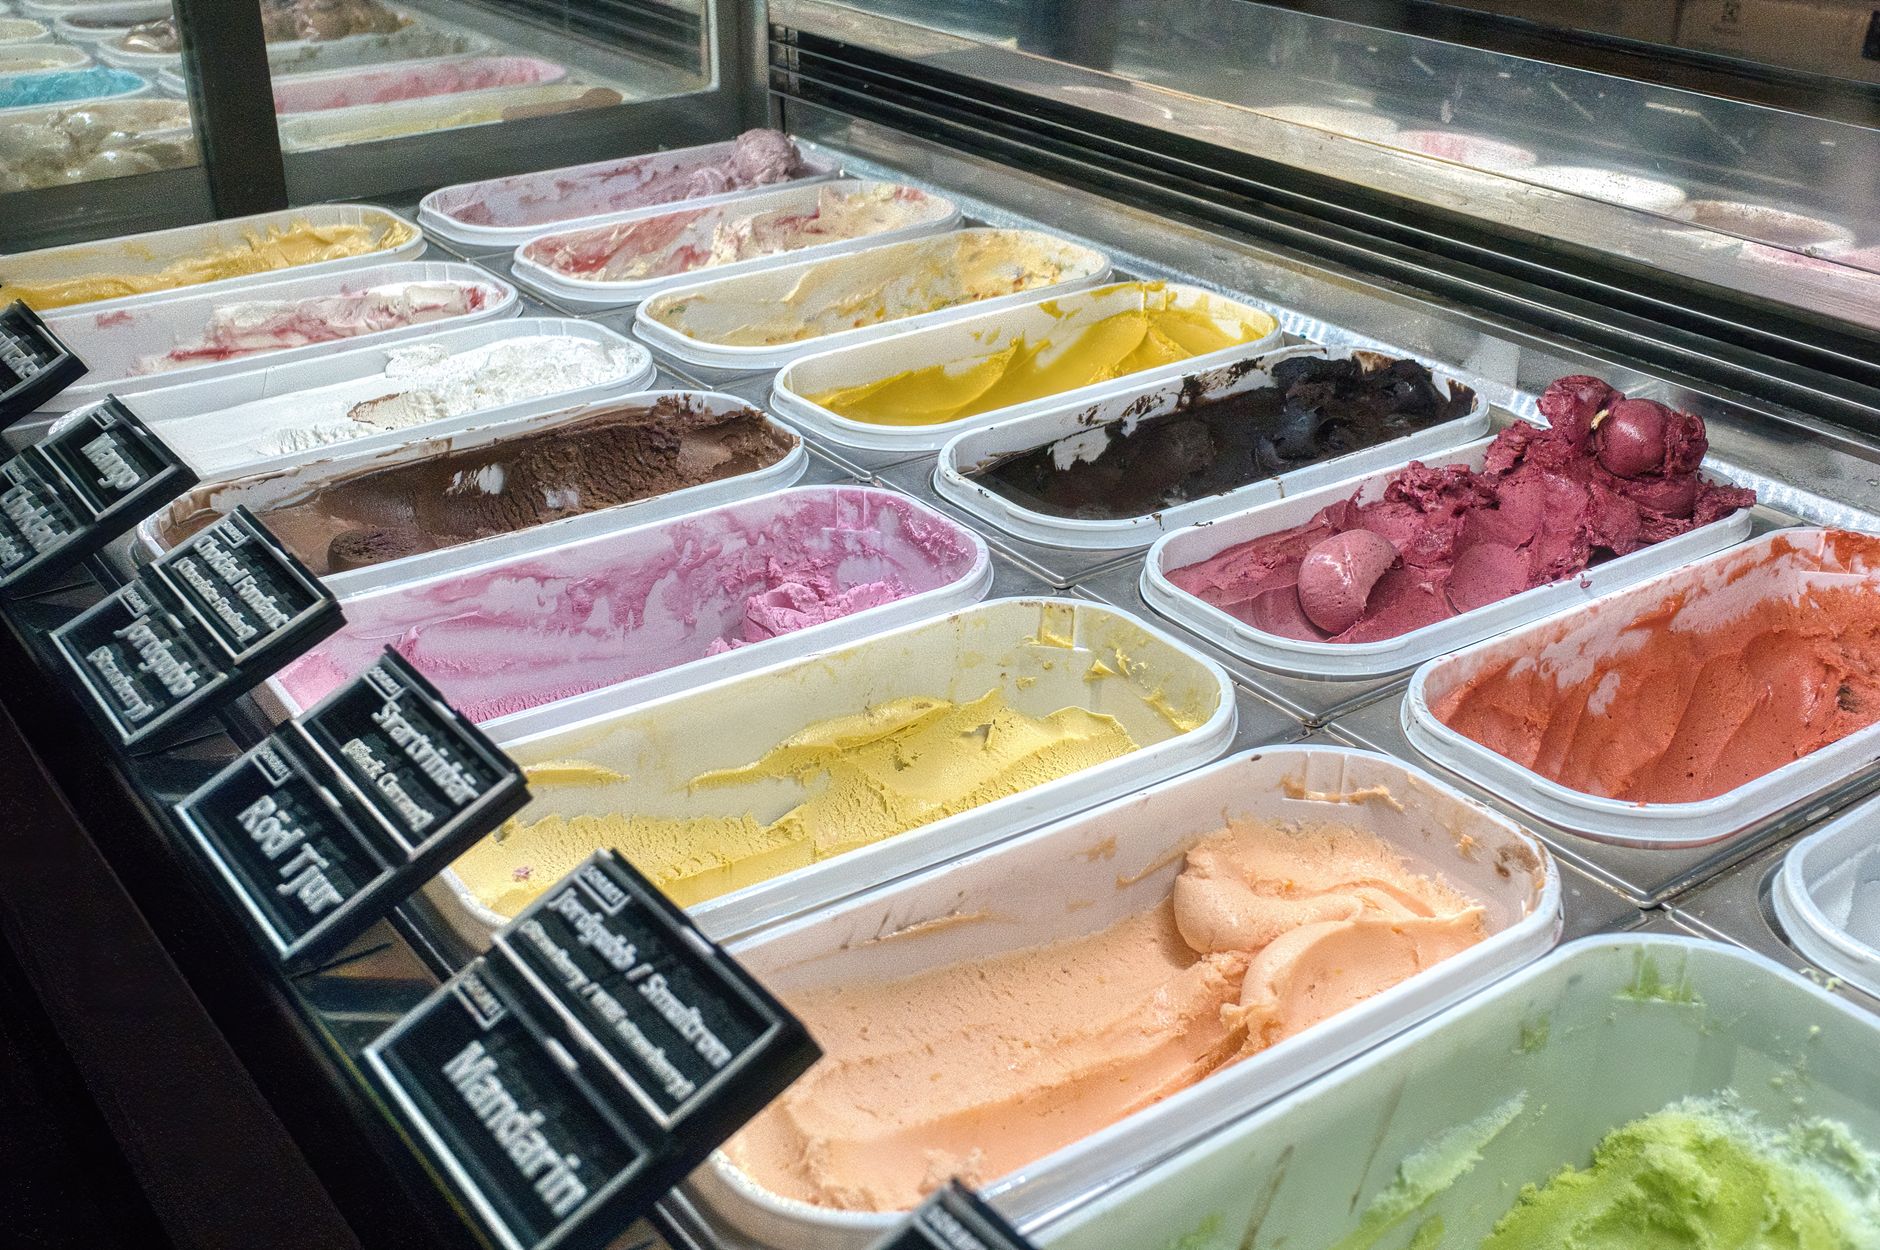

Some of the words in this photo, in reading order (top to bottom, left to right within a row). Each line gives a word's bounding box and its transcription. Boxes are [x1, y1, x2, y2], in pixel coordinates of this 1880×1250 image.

[81, 433, 141, 488] Mango
[114, 615, 200, 698] Jordgubb
[238, 796, 305, 856] Röd
[277, 843, 344, 912] Tjur
[639, 974, 731, 1066] Smultron
[442, 1041, 588, 1218] Mandarin
